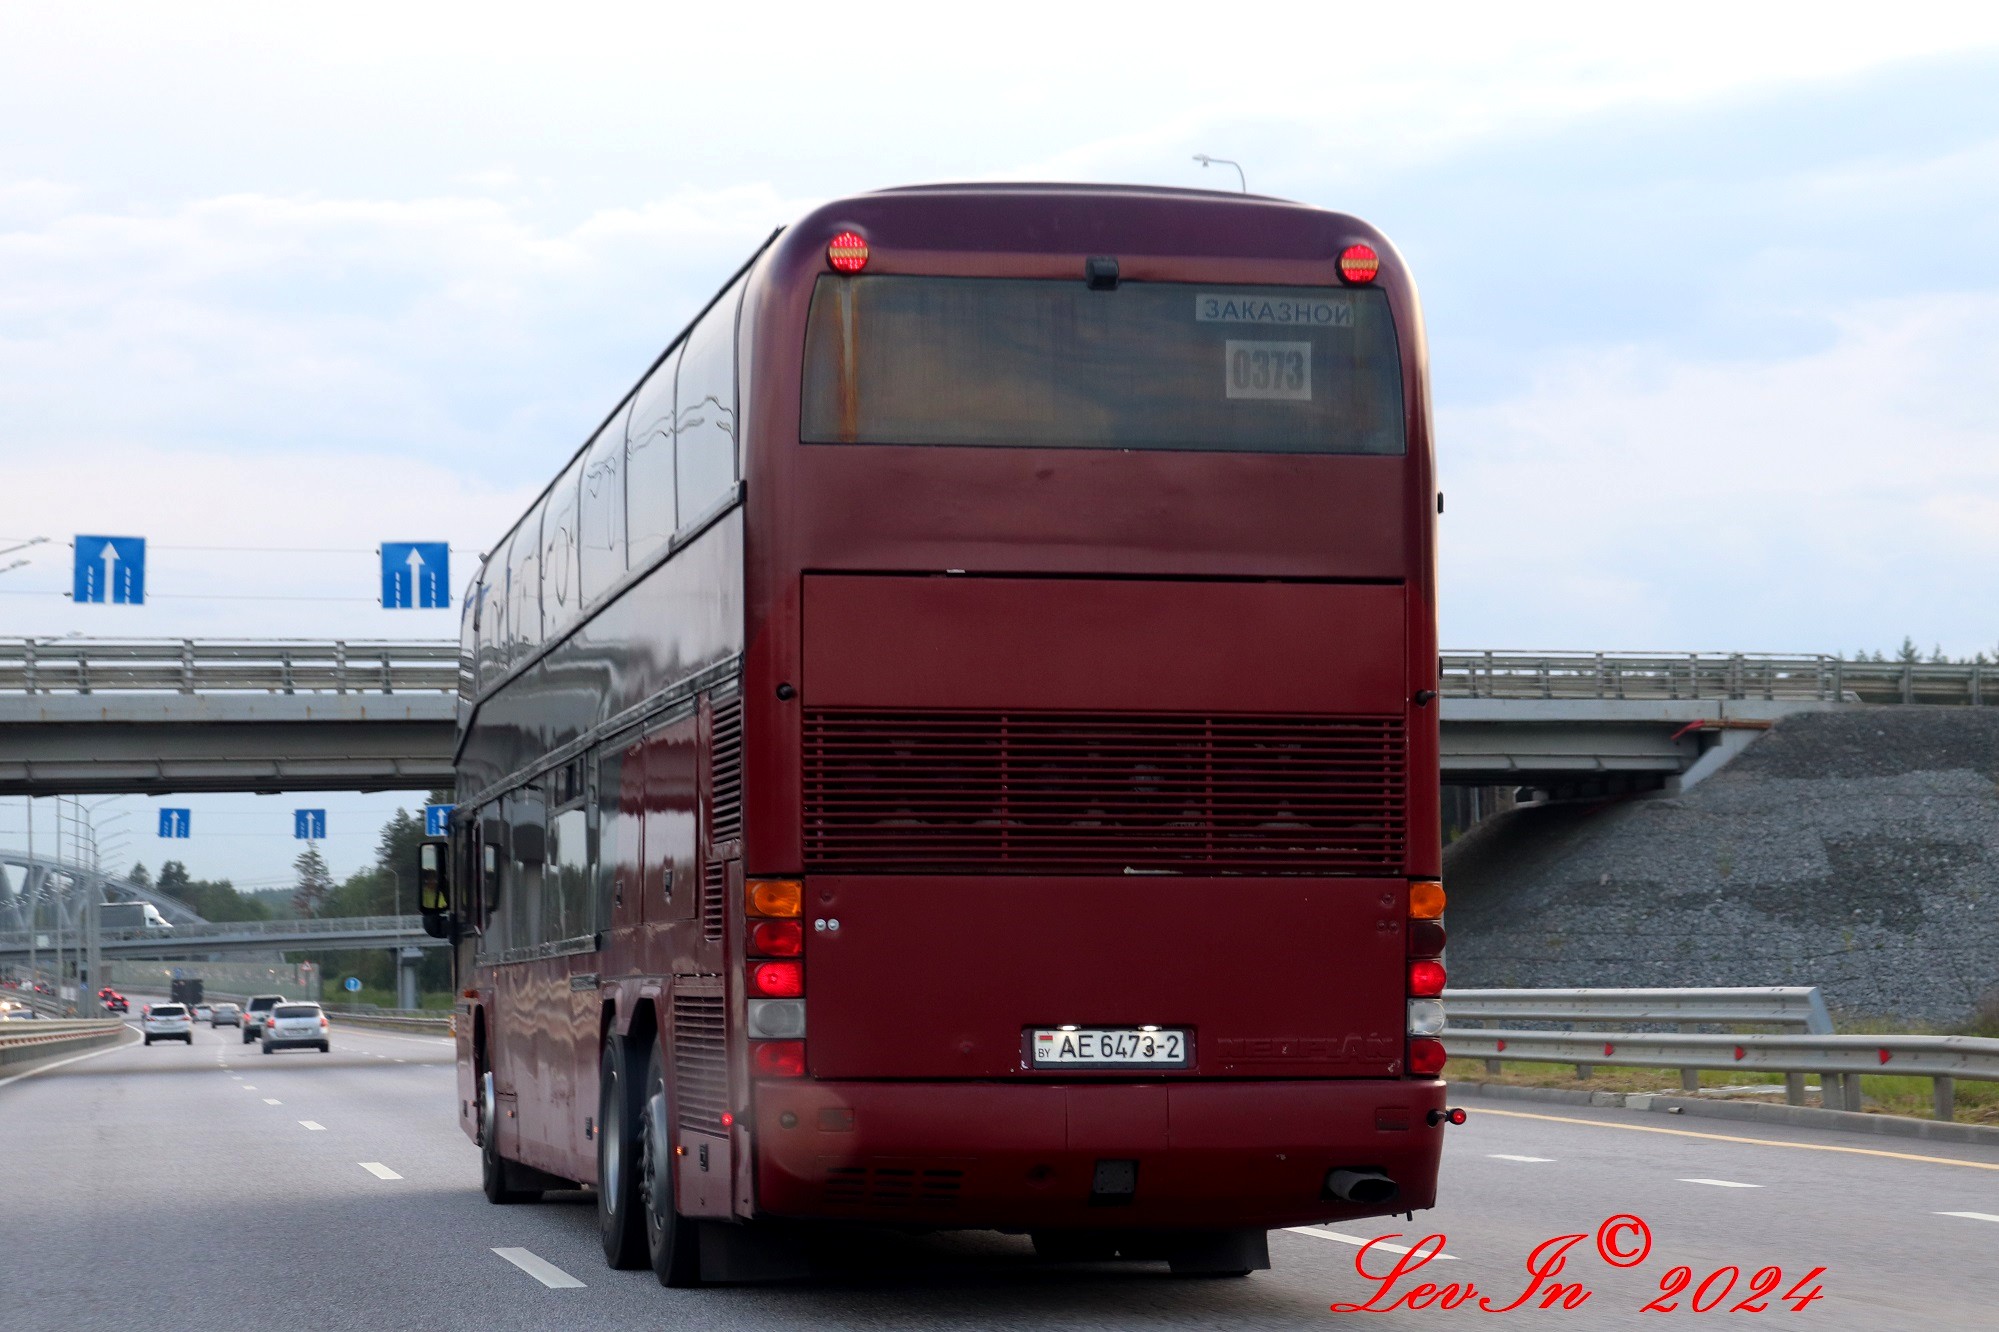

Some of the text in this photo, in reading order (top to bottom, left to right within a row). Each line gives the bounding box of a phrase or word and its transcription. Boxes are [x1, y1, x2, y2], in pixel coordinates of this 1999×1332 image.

[1205, 298, 1350, 325] ЗАКАЗНОЙ
[1232, 350, 1304, 391] 0373
[1038, 1048, 1051, 1058] BY
[1059, 1035, 1180, 1058] AE 6473-2
